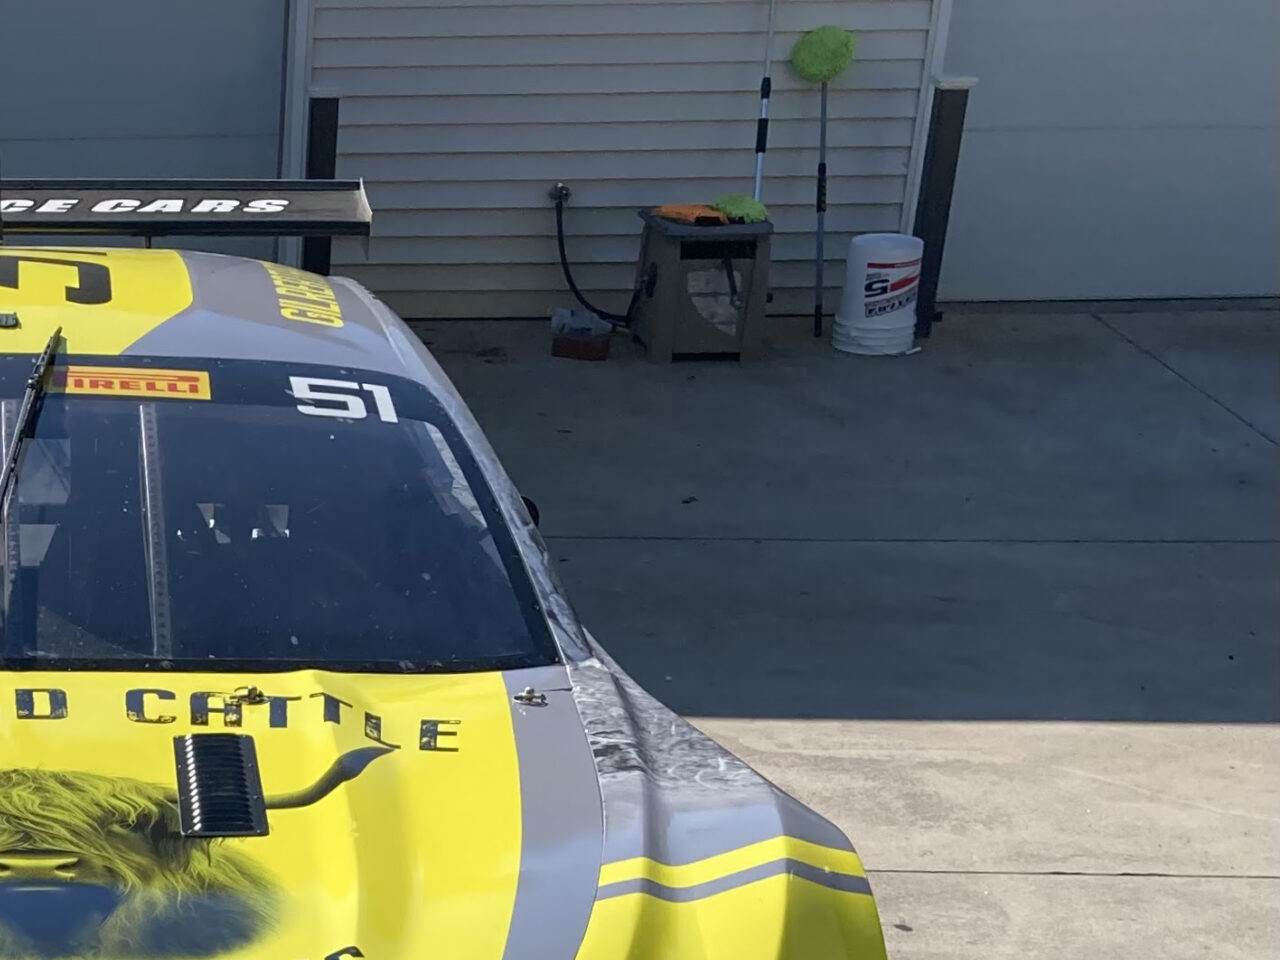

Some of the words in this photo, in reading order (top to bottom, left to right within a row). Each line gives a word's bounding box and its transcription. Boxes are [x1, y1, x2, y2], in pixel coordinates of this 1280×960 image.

[90, 198, 290, 213] CARS
[289, 376, 399, 423] 51
[125, 688, 460, 752] CATTLE
